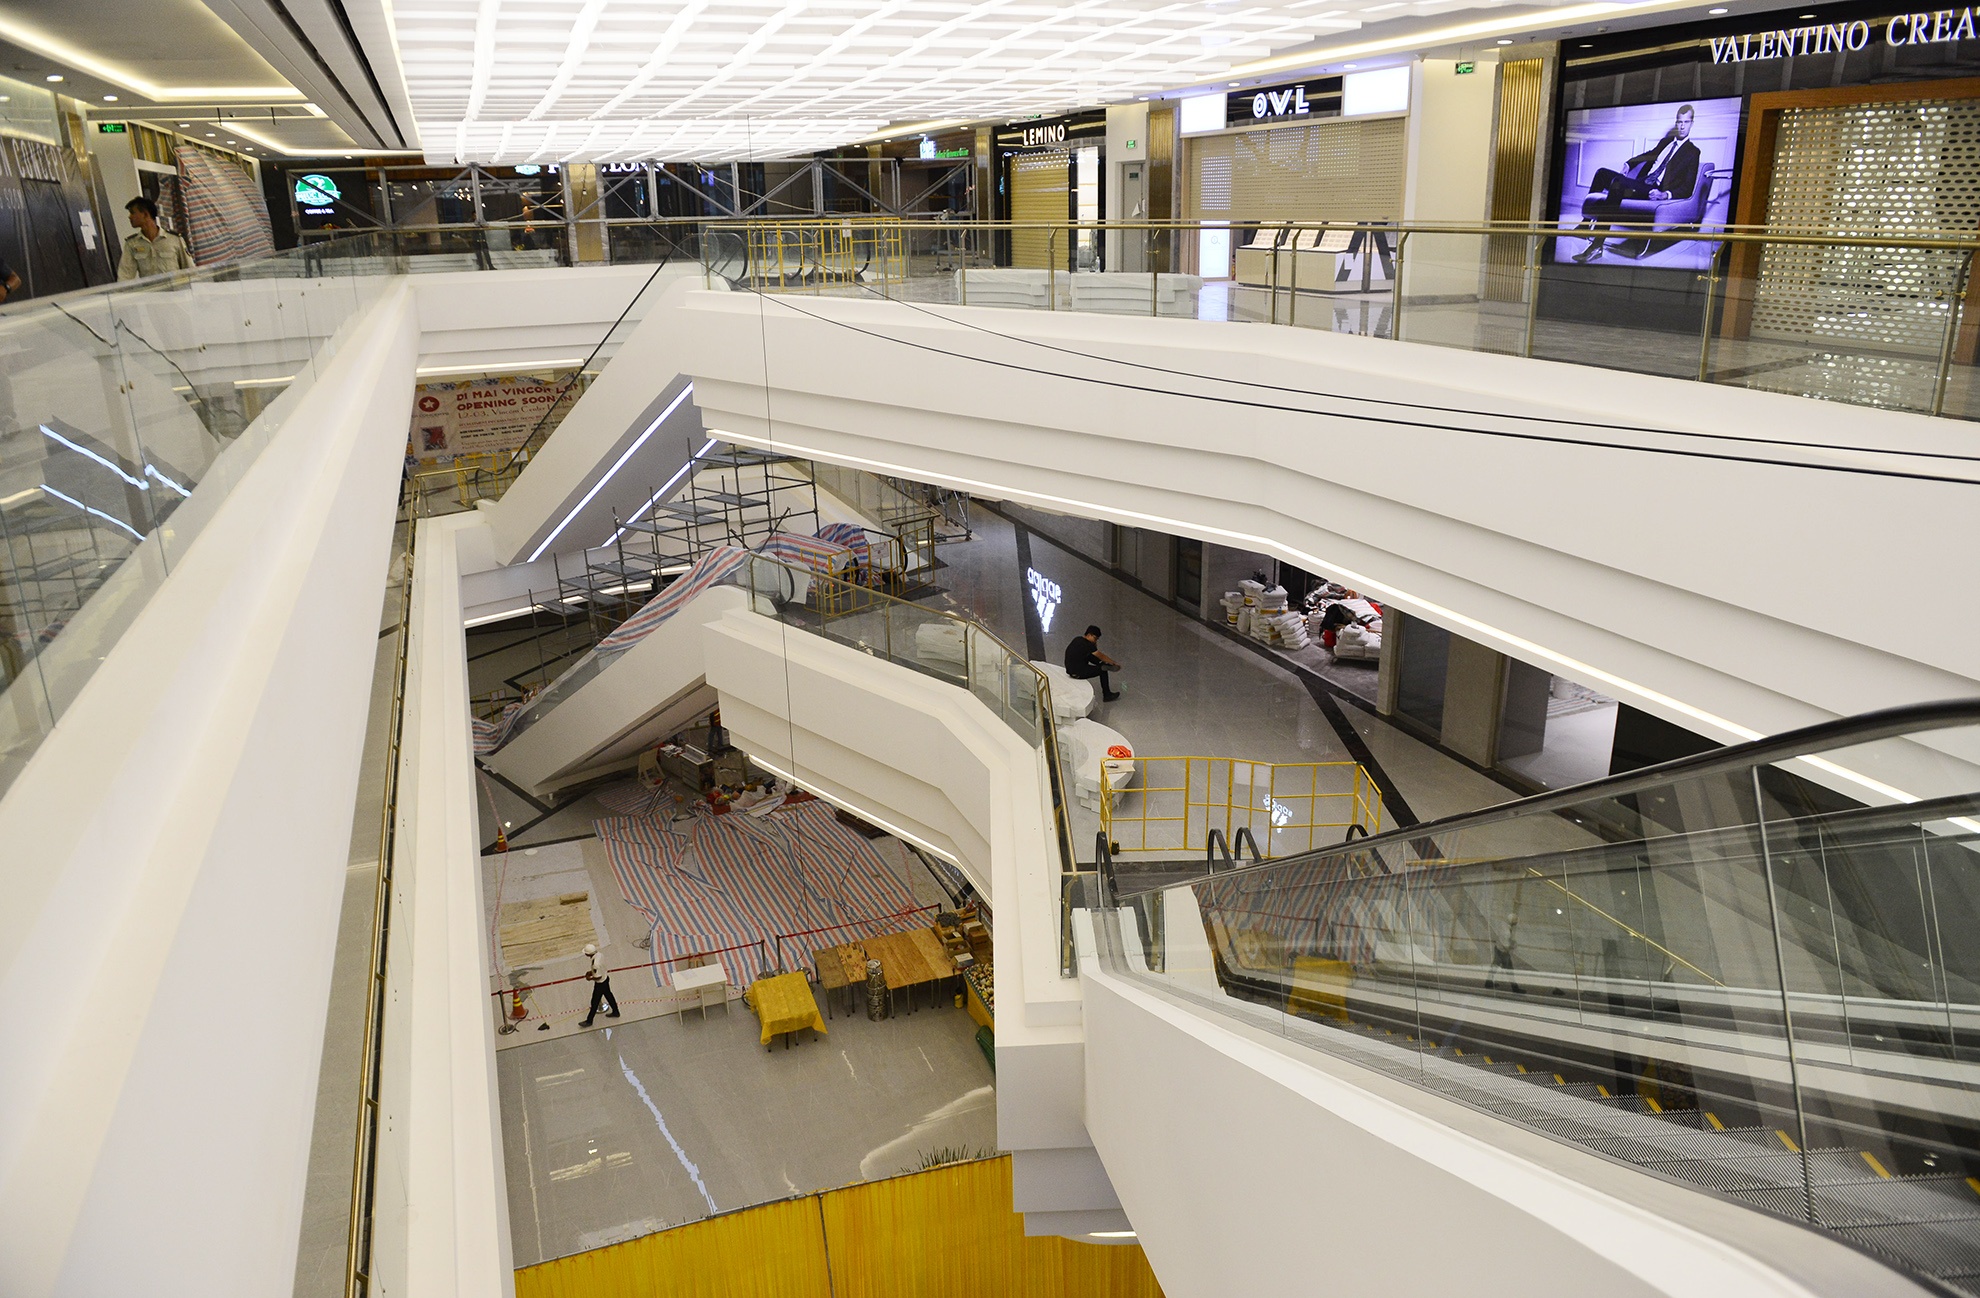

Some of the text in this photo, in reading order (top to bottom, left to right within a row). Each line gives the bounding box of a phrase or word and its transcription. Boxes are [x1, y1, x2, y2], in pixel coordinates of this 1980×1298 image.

[1708, 7, 1980, 65] VALENTINO CREA
[1023, 124, 1065, 146] LEMINO
[12, 137, 69, 182] CONCEPT
[456, 393, 468, 401] DI
[472, 390, 498, 399] MAI
[457, 398, 517, 411] OPENING
[522, 395, 556, 404] SOON
